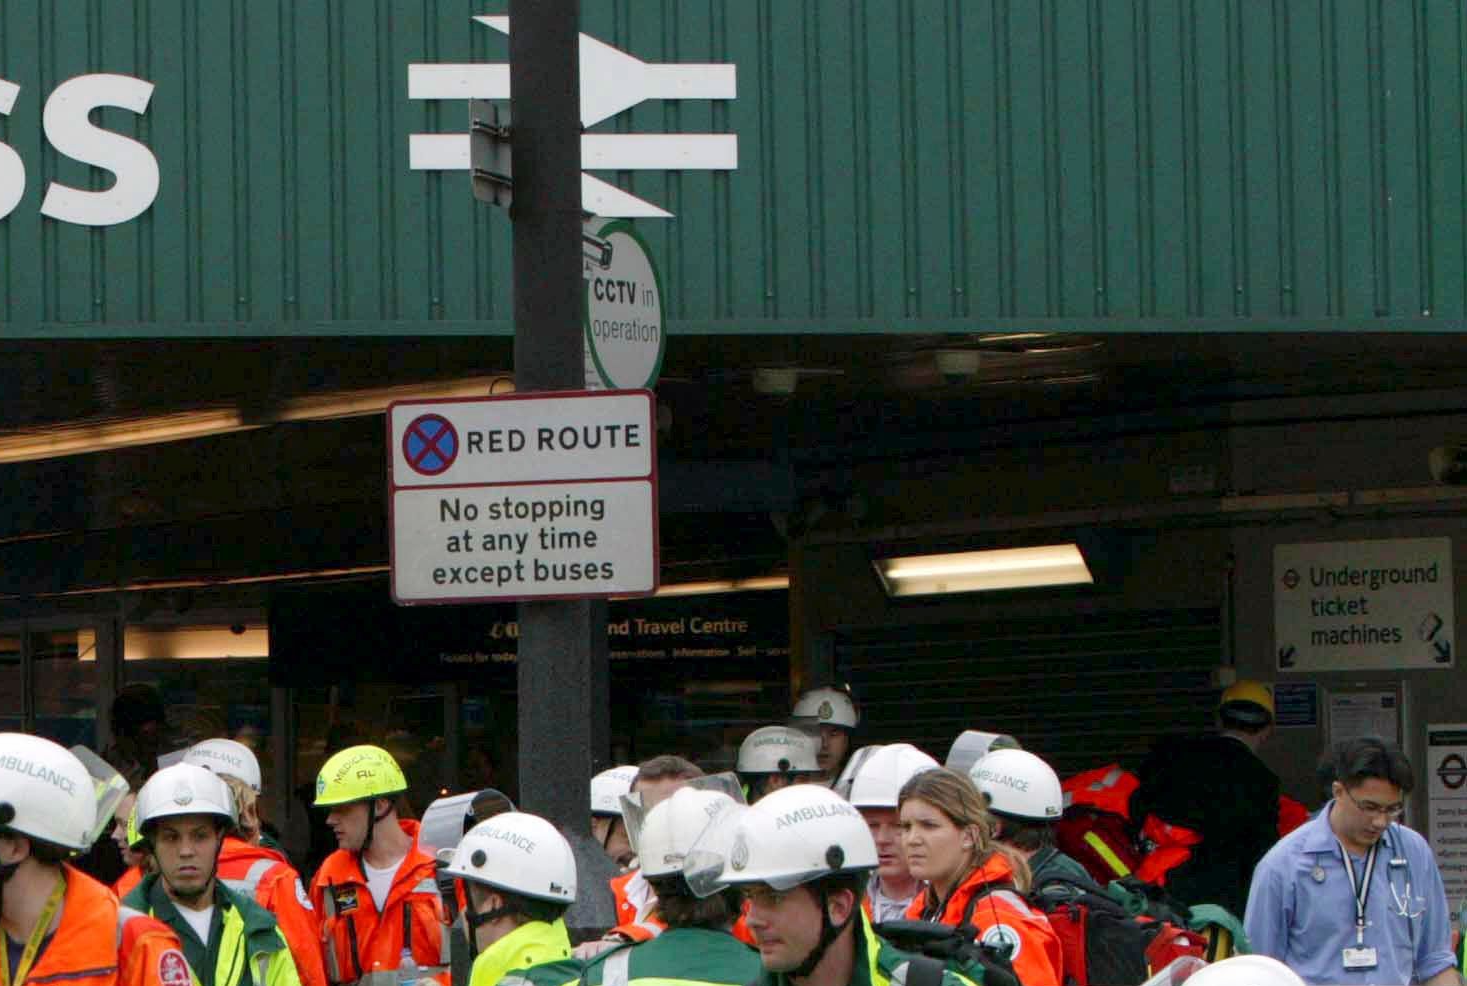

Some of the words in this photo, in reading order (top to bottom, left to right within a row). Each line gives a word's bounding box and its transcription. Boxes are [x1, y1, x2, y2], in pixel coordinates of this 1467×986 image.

[594, 277, 637, 305] CCTV
[642, 284, 654, 308] in
[593, 318, 659, 344] operation
[466, 429, 527, 454] RED
[537, 424, 640, 450] ROUTE
[439, 498, 479, 522] No
[489, 494, 605, 522] stopping
[446, 530, 473, 553] at
[482, 532, 529, 555] any
[538, 527, 598, 550] time
[433, 559, 525, 587] except
[534, 558, 614, 582] buses
[1310, 562, 1439, 590] Underground
[1310, 596, 1370, 617] ticket
[636, 617, 685, 636] Travel
[690, 616, 749, 635] Centre
[1310, 624, 1403, 647] machines
[776, 802, 858, 830] AMBULAN
